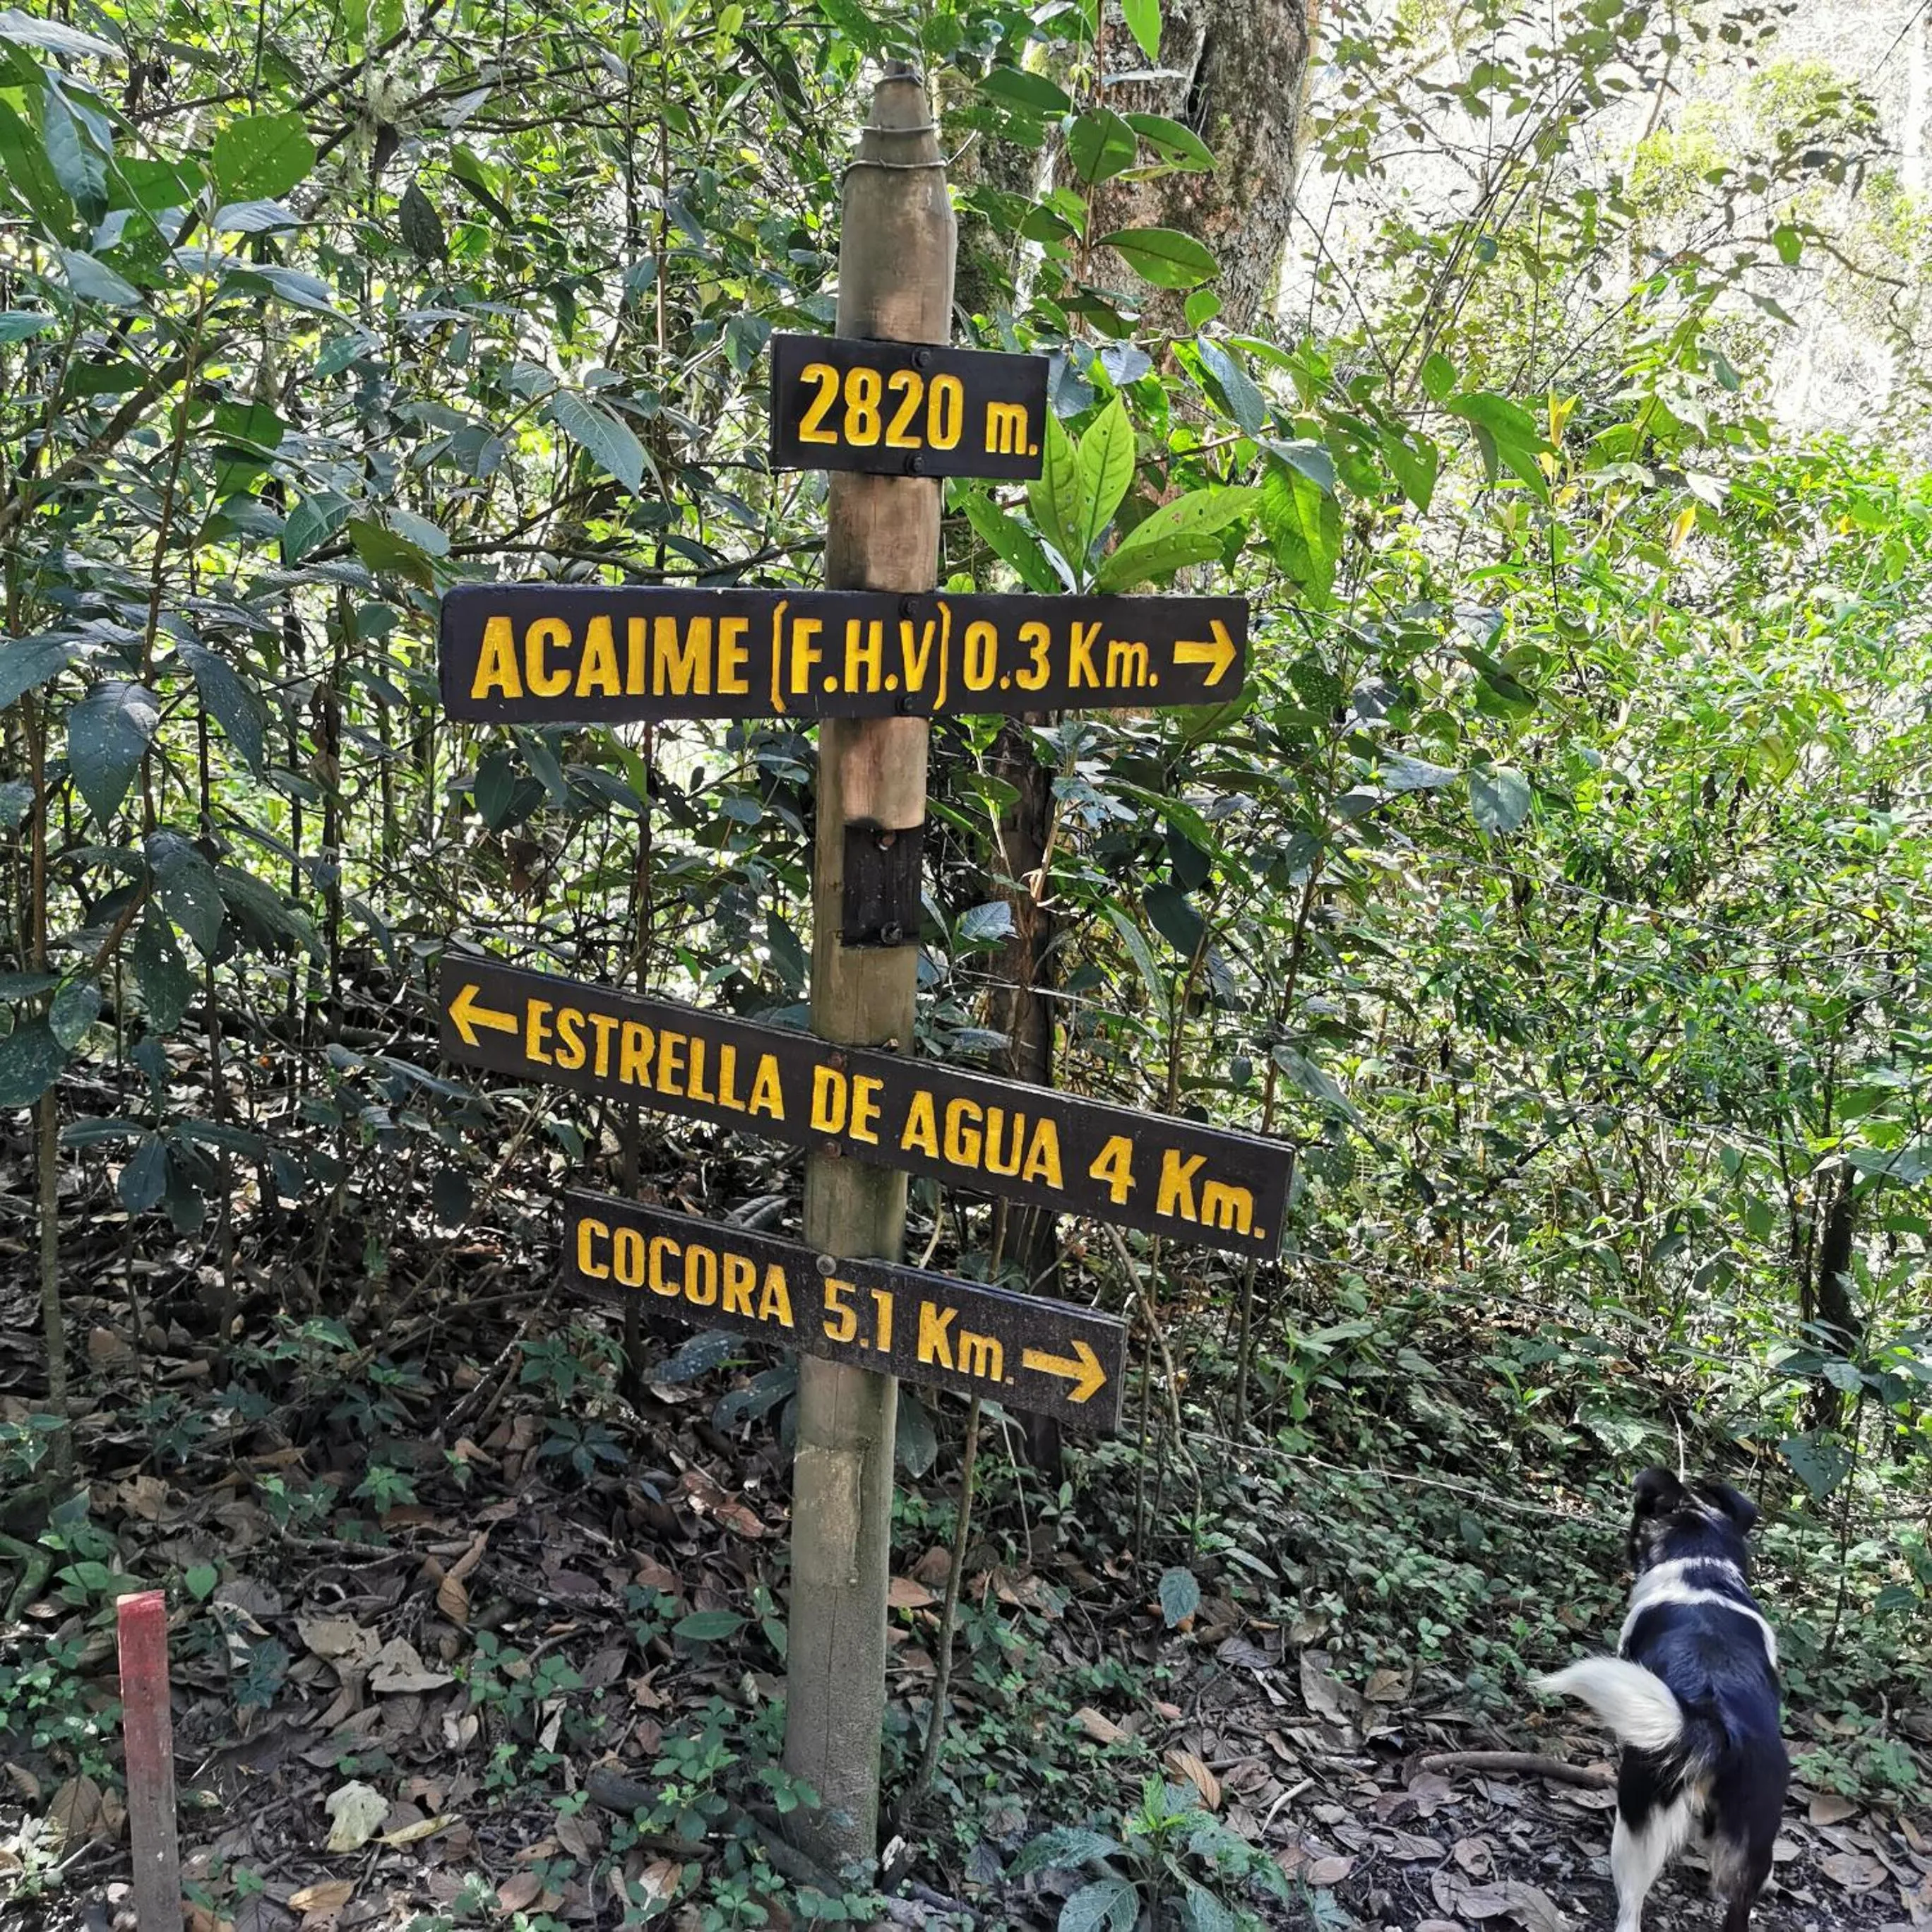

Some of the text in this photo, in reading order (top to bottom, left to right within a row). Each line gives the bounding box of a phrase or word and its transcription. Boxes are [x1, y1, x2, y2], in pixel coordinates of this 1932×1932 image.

[798, 362, 1039, 457] 2820 m.
[470, 616, 749, 700] ACAIME
[962, 620, 1051, 692] 0.3
[1068, 621, 1159, 689] Km.
[525, 997, 1267, 1240] ESTRELLA DE AGUA 4 Km.
[576, 1217, 1015, 1386] COCORA 5.1 Km.
